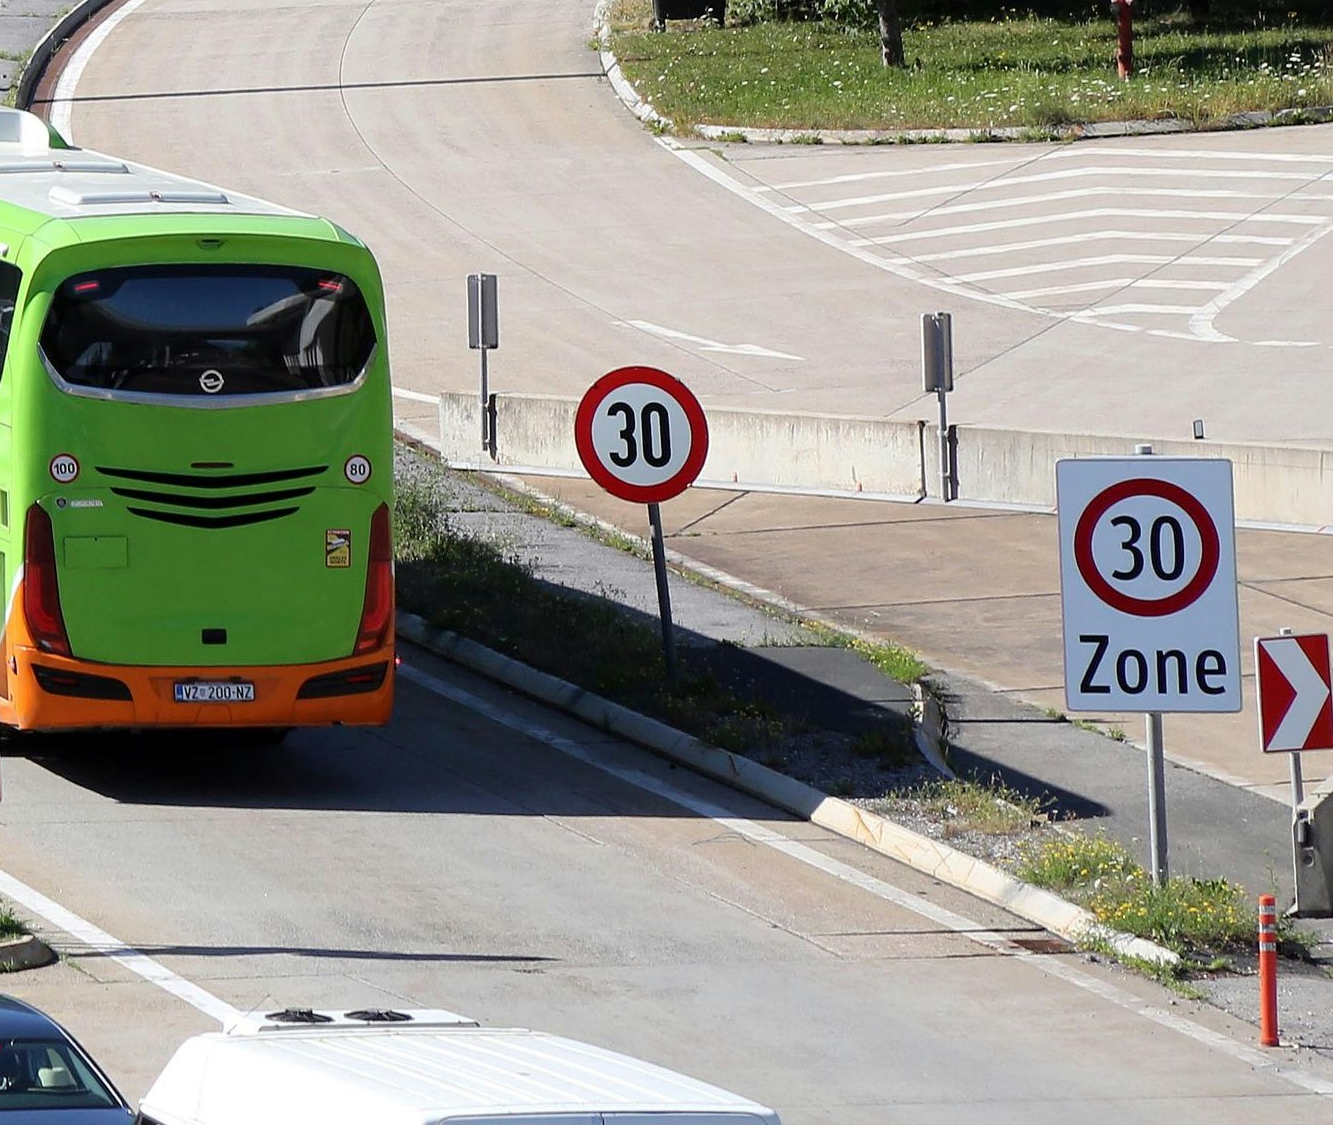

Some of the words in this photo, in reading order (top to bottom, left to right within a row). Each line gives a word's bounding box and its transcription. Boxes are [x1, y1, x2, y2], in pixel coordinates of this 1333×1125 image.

[608, 402, 671, 467] 30
[54, 463, 76, 475] 100
[350, 463, 366, 476] 80
[1111, 516, 1184, 581] 30
[1079, 635, 1227, 695] Zone
[184, 686, 199, 699] VZ
